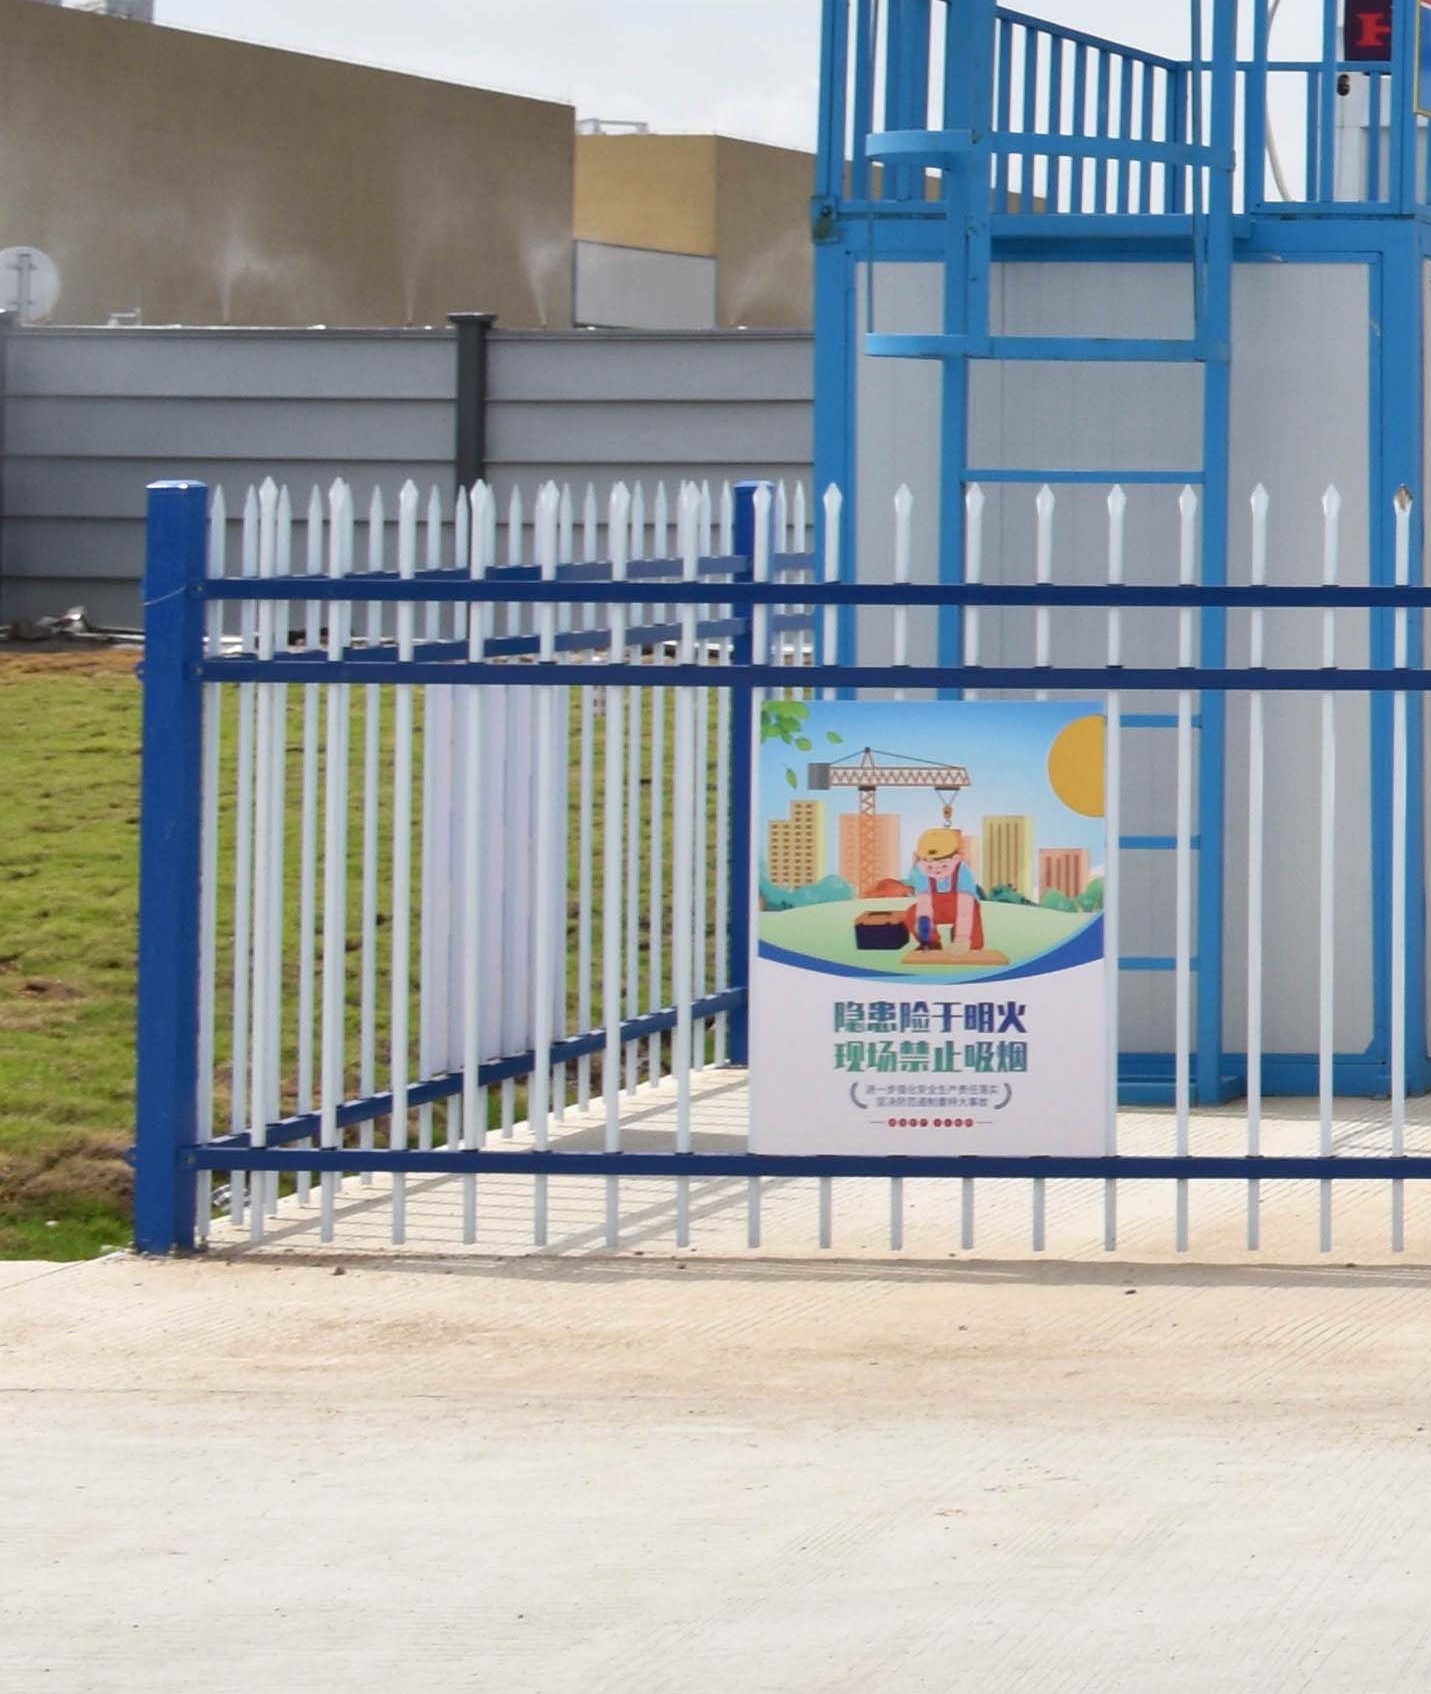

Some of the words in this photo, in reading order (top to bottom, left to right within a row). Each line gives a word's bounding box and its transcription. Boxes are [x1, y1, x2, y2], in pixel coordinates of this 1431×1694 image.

[834, 1001, 1027, 1033] 隐患险于明火
[834, 1040, 1028, 1072] 现场禁止吸烟
